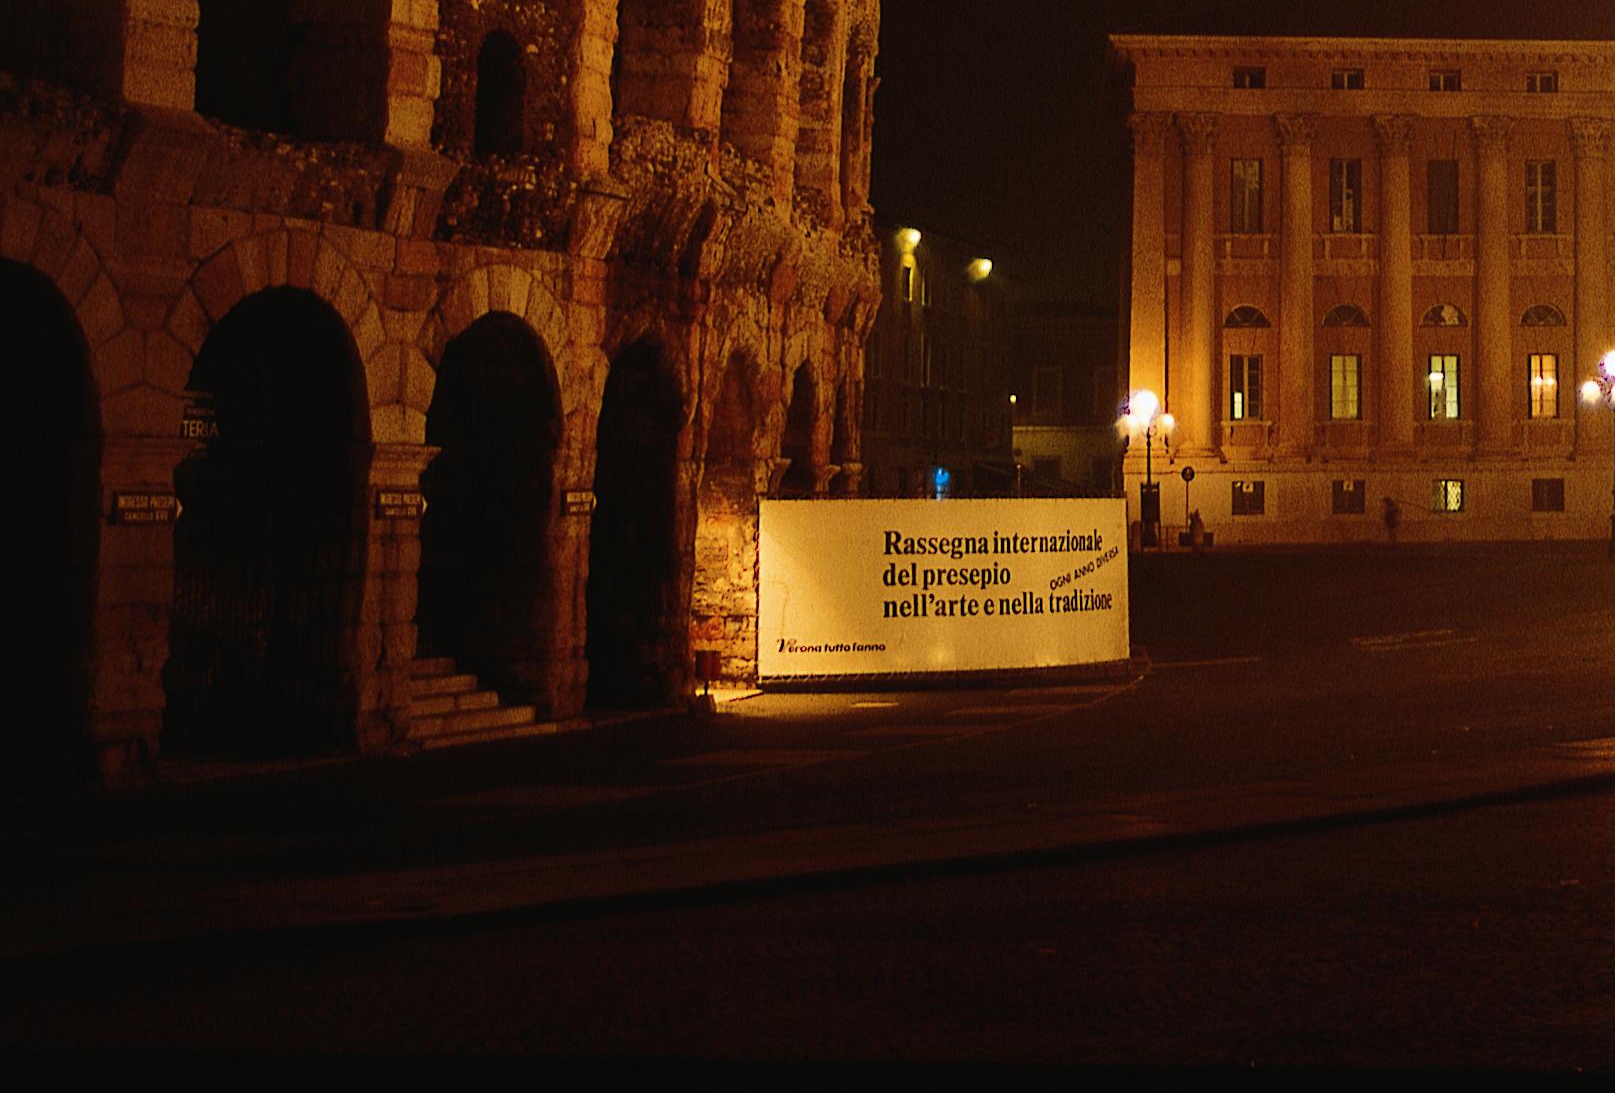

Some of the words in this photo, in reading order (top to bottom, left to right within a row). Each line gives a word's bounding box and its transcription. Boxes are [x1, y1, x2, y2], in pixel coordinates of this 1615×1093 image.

[884, 530, 989, 559] Rassegna
[993, 528, 1102, 554] internazionale
[883, 562, 917, 586] del
[923, 561, 1011, 590] presepio
[1050, 573, 1071, 590] OGNI
[1074, 561, 1094, 579] ANNO
[1096, 546, 1118, 568] DIVERSA
[883, 593, 979, 618] nell'arte
[983, 598, 995, 616] e
[999, 591, 1044, 615] nella
[1049, 589, 1112, 613] tradizione
[776, 638, 822, 653] Verona
[824, 643, 851, 653] tutto
